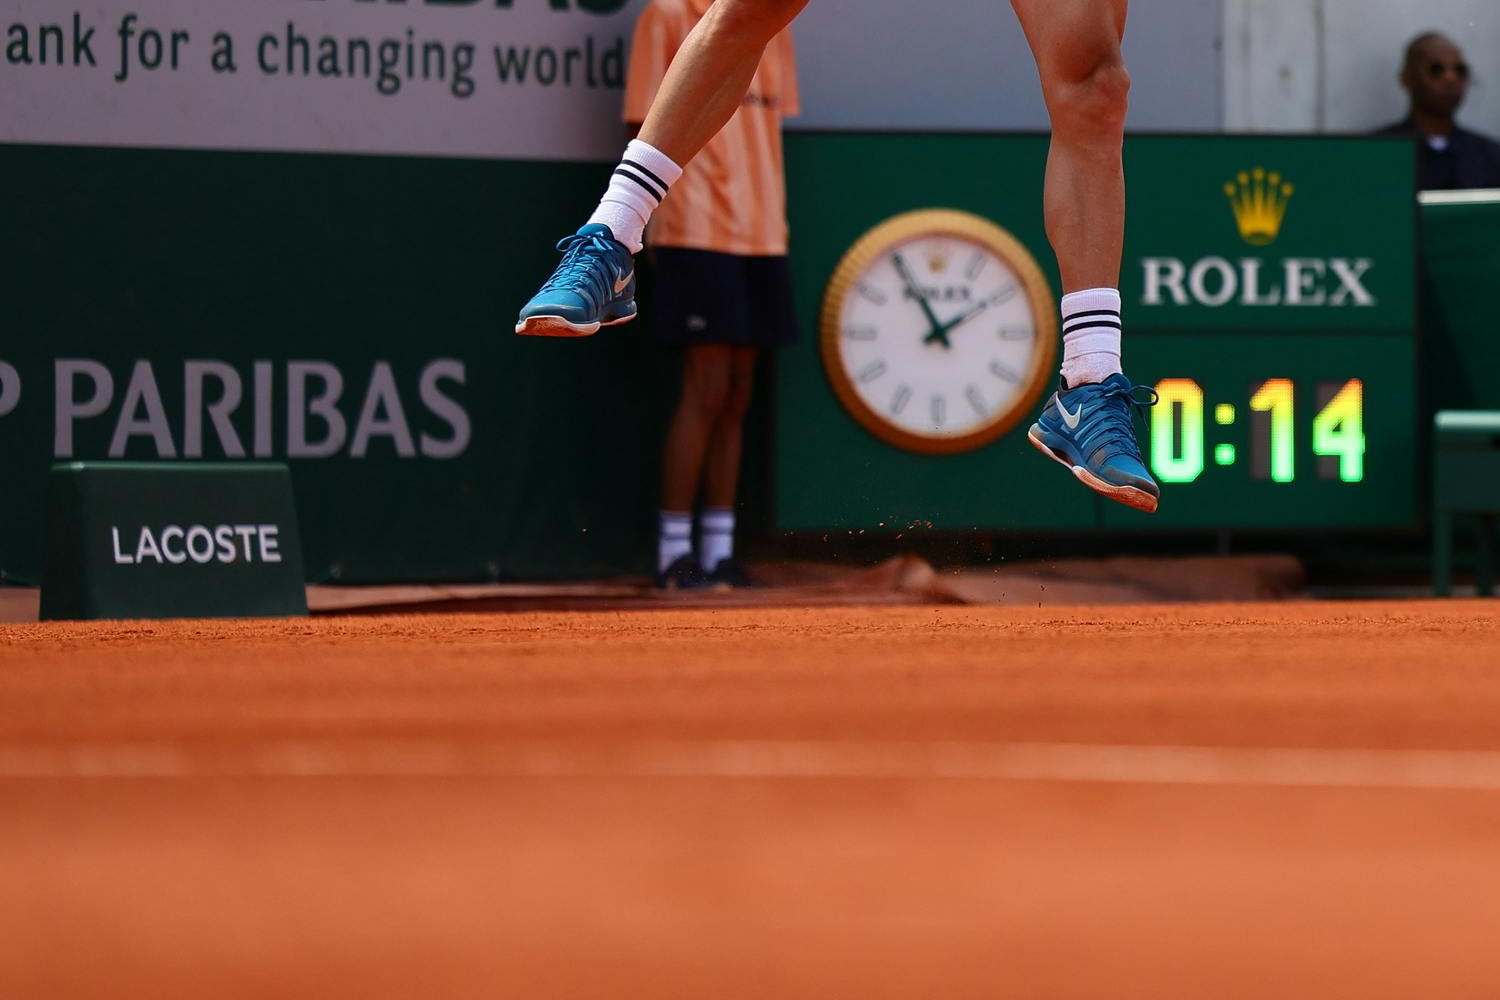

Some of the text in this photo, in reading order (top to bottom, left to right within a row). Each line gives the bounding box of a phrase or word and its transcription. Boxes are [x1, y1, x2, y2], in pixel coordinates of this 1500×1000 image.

[114, 12, 190, 83] for
[211, 30, 237, 73] a
[257, 21, 475, 100] changing
[493, 33, 625, 89] world
[1140, 256, 1376, 307] ROLEX
[54, 358, 472, 459] PARIBAS
[1151, 378, 1366, 483] 0:14
[112, 525, 281, 564] LACOSTE
